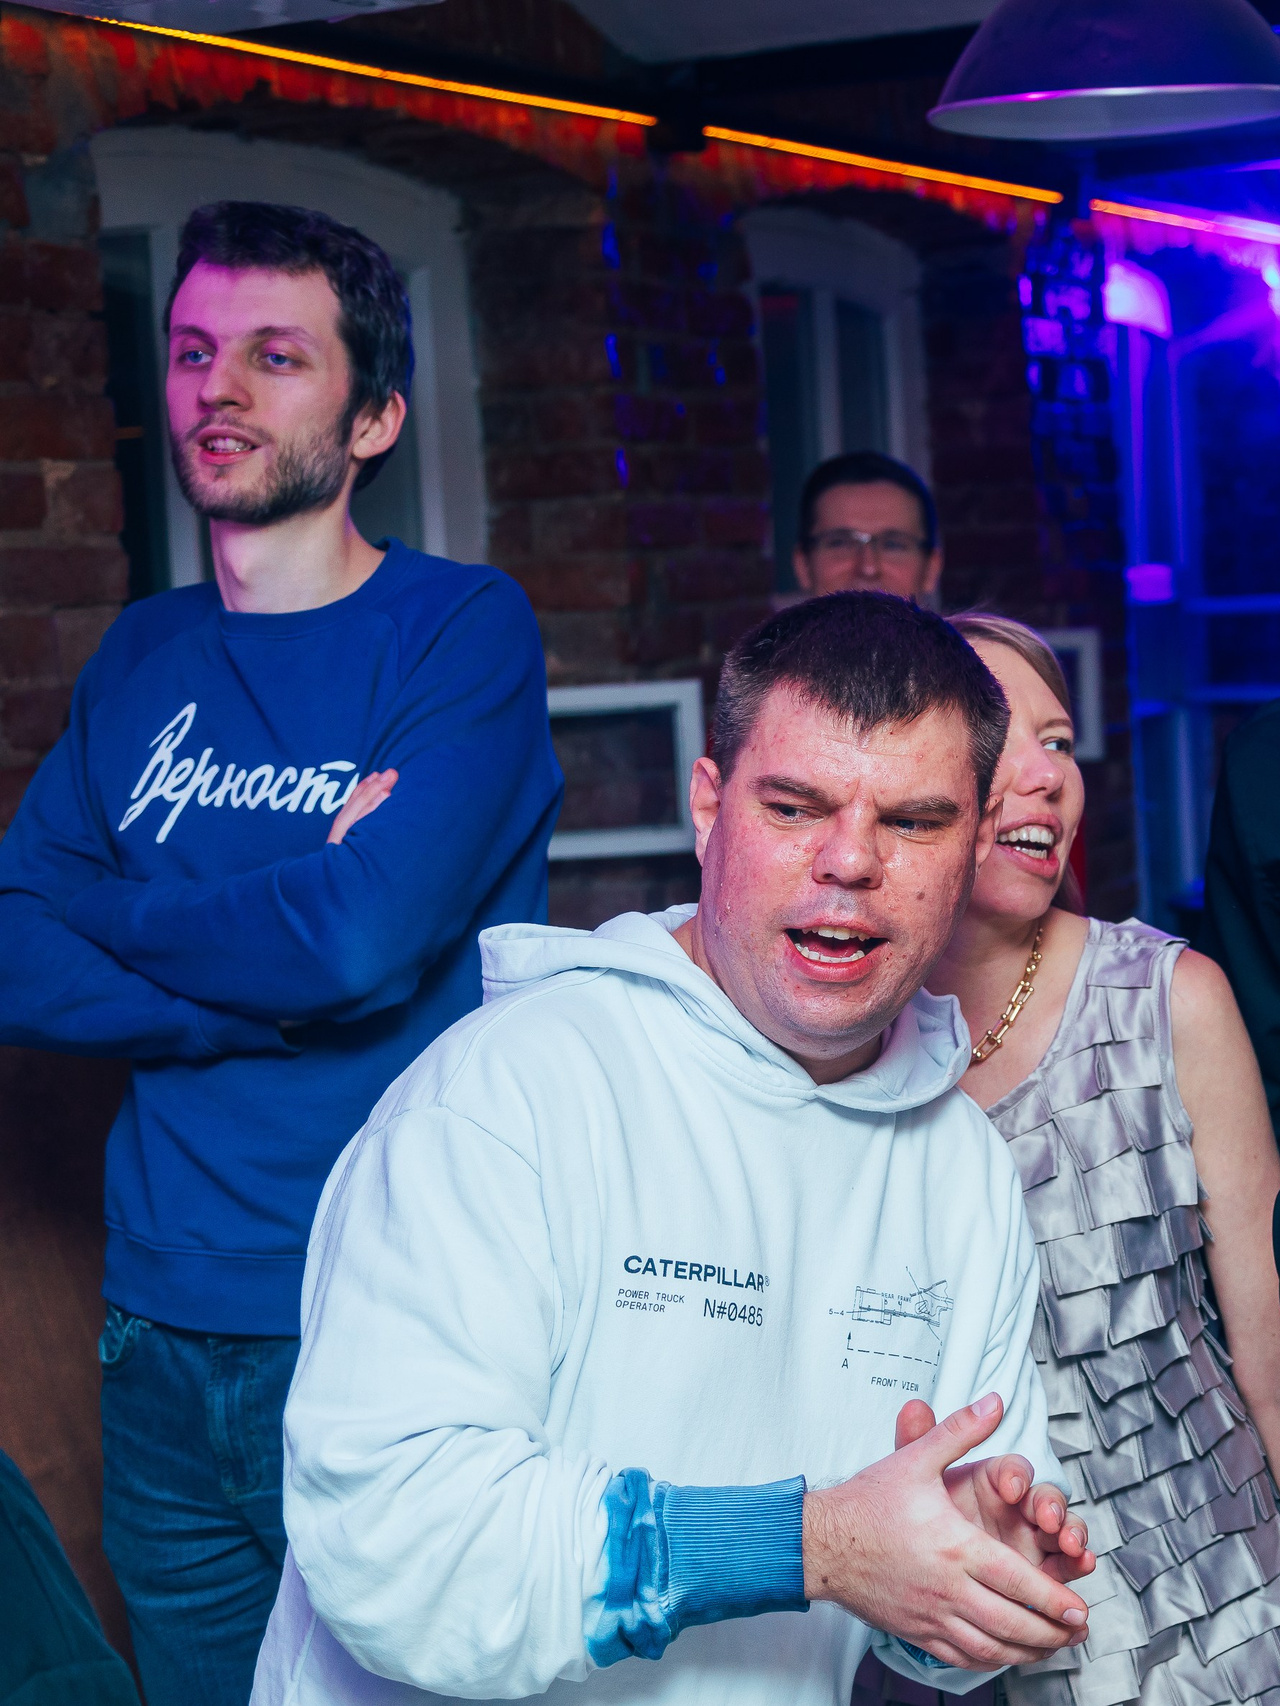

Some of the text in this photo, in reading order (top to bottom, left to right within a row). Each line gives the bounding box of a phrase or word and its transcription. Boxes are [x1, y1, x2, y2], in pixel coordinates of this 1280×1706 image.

[617, 1288, 685, 1304] POWER TRUCK
[615, 1299, 666, 1313] OPERATOR
[703, 1297, 763, 1327] N#0485
[841, 1357, 849, 1369] A
[870, 1376, 920, 1392] FRONT VIEW
